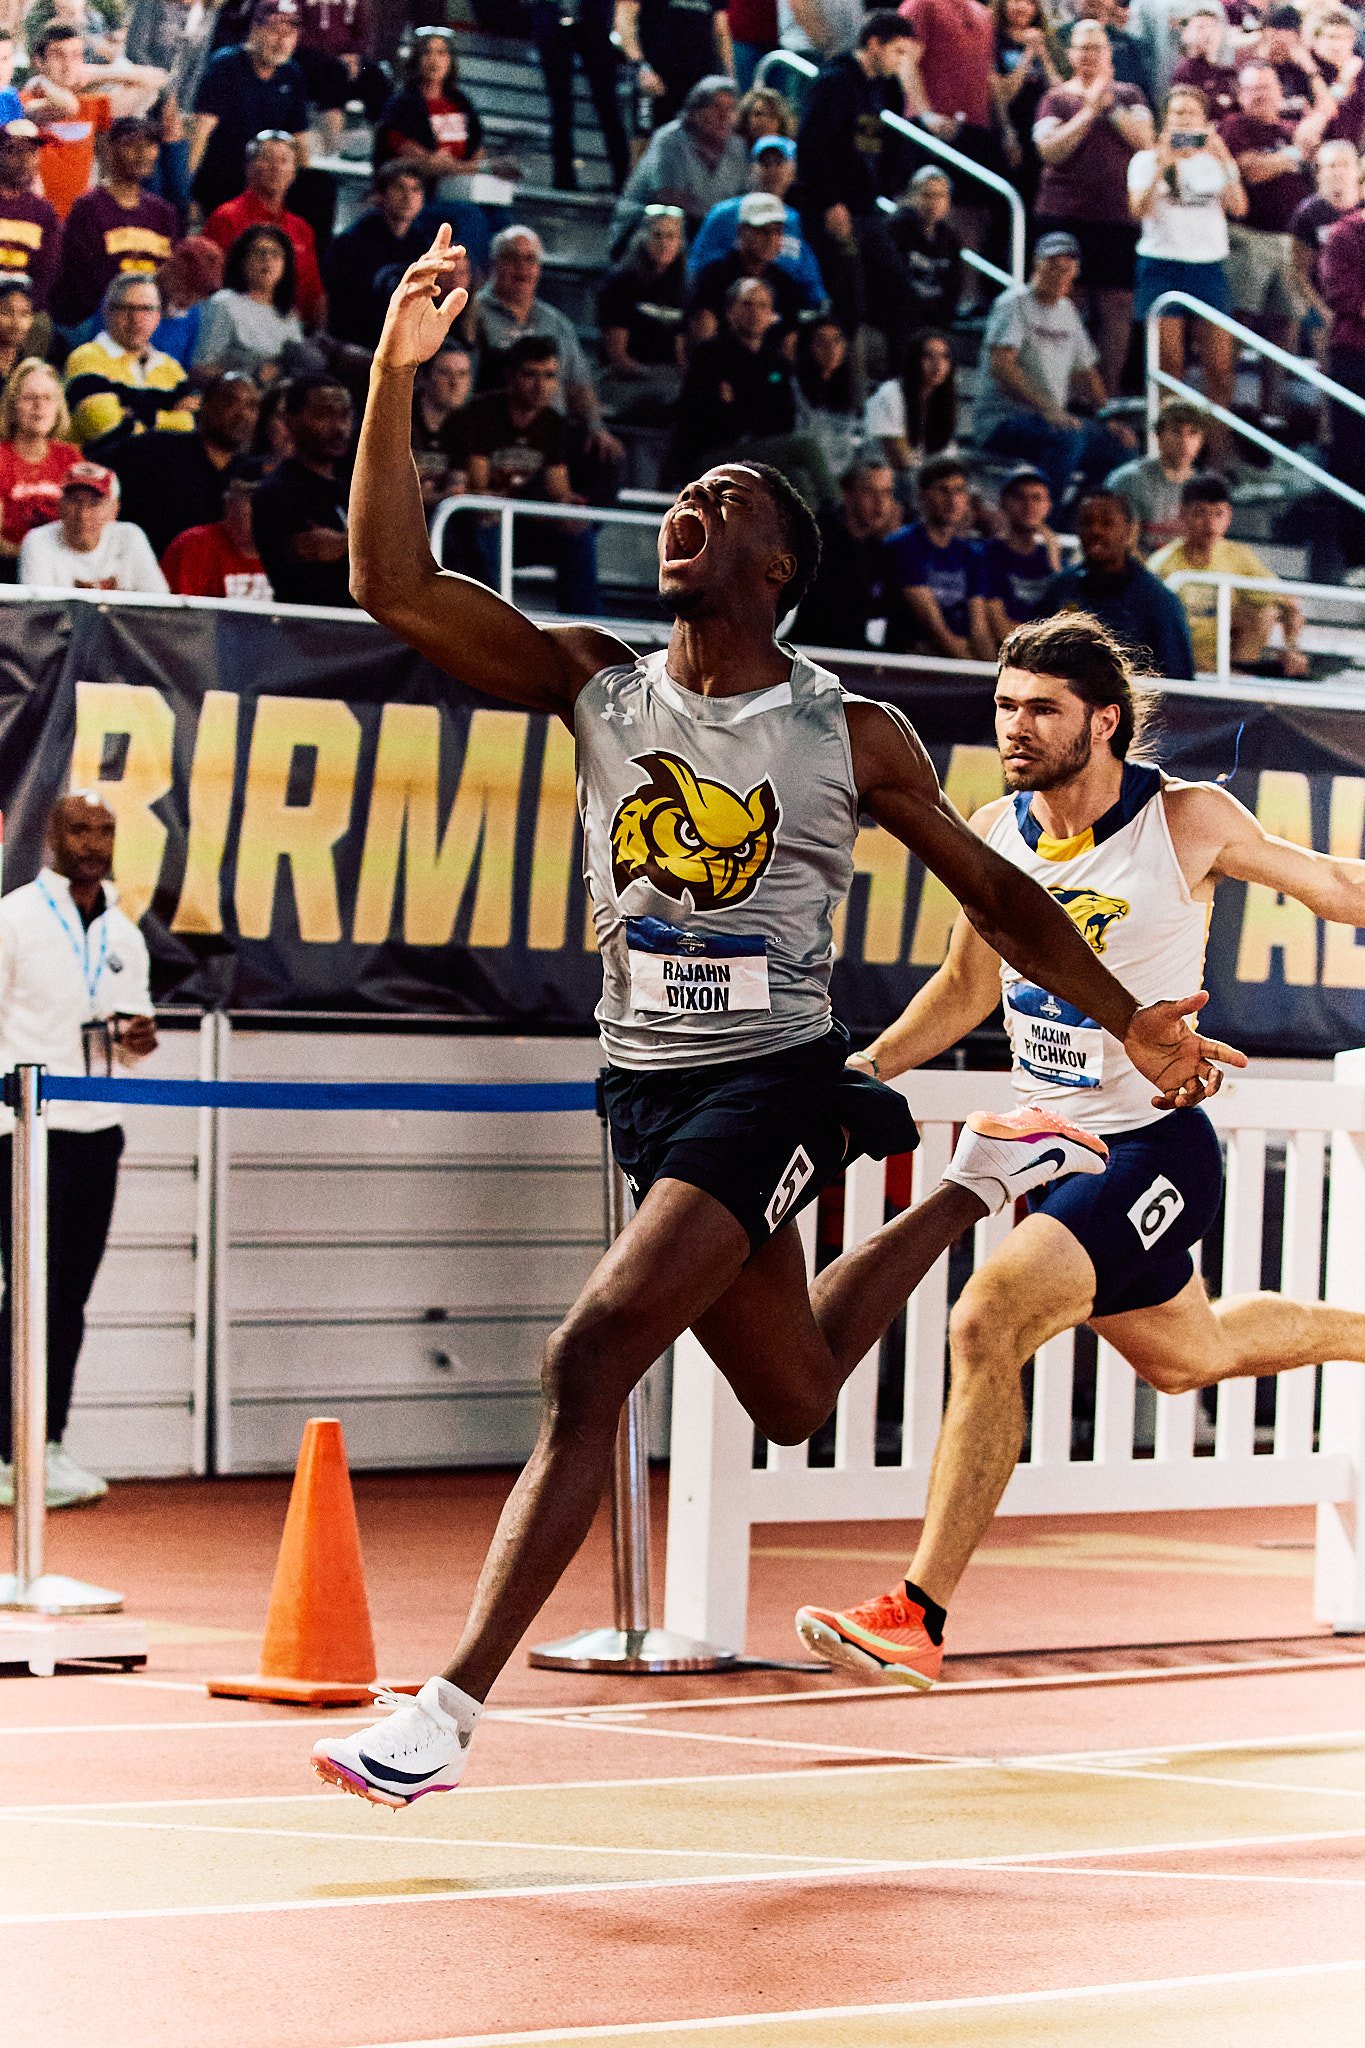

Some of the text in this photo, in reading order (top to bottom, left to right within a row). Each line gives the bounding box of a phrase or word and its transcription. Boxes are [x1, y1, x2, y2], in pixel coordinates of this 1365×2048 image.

[663, 960, 731, 983] RAJAHN
[666, 985, 730, 1011] DIXON
[1031, 1023, 1072, 1047] MAXIM
[1024, 1038, 1087, 1069] RYCHKOV
[771, 1153, 809, 1224] 5
[1140, 1188, 1179, 1236] 6
